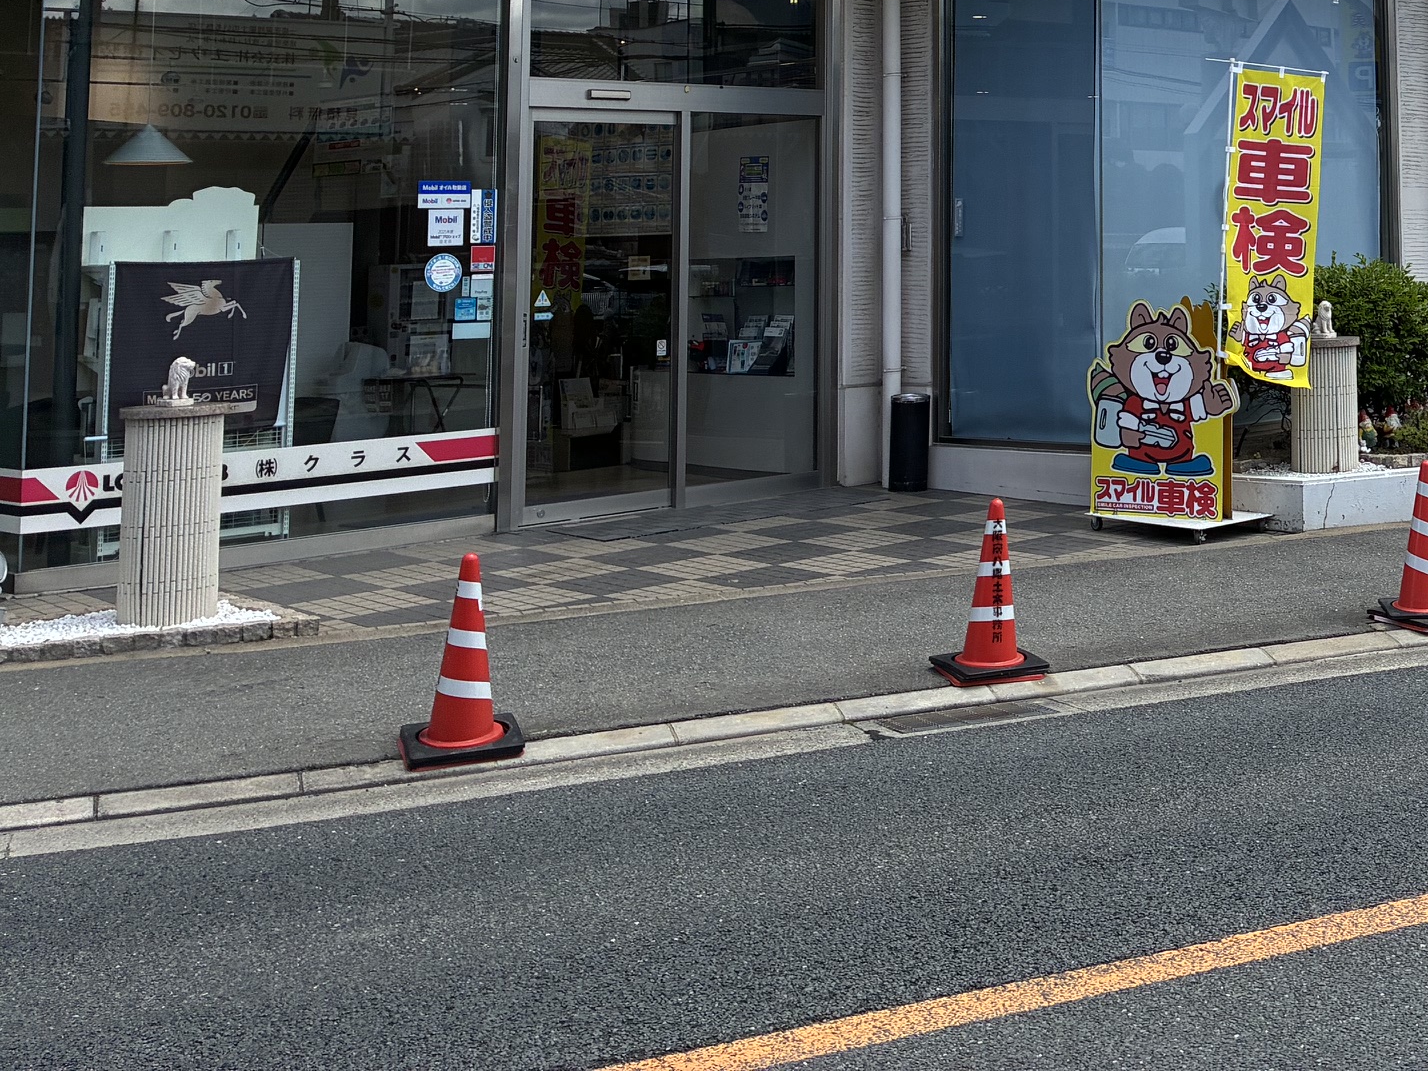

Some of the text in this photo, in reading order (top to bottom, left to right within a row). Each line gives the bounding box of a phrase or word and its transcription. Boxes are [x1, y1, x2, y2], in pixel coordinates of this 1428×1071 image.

[1239, 82, 1317, 138] スマイル
[434, 215, 458, 224] Mobil
[1231, 138, 1315, 276] 車検
[215, 389, 254, 401] YEARS
[1096, 477, 1217, 519] スマイル車検
